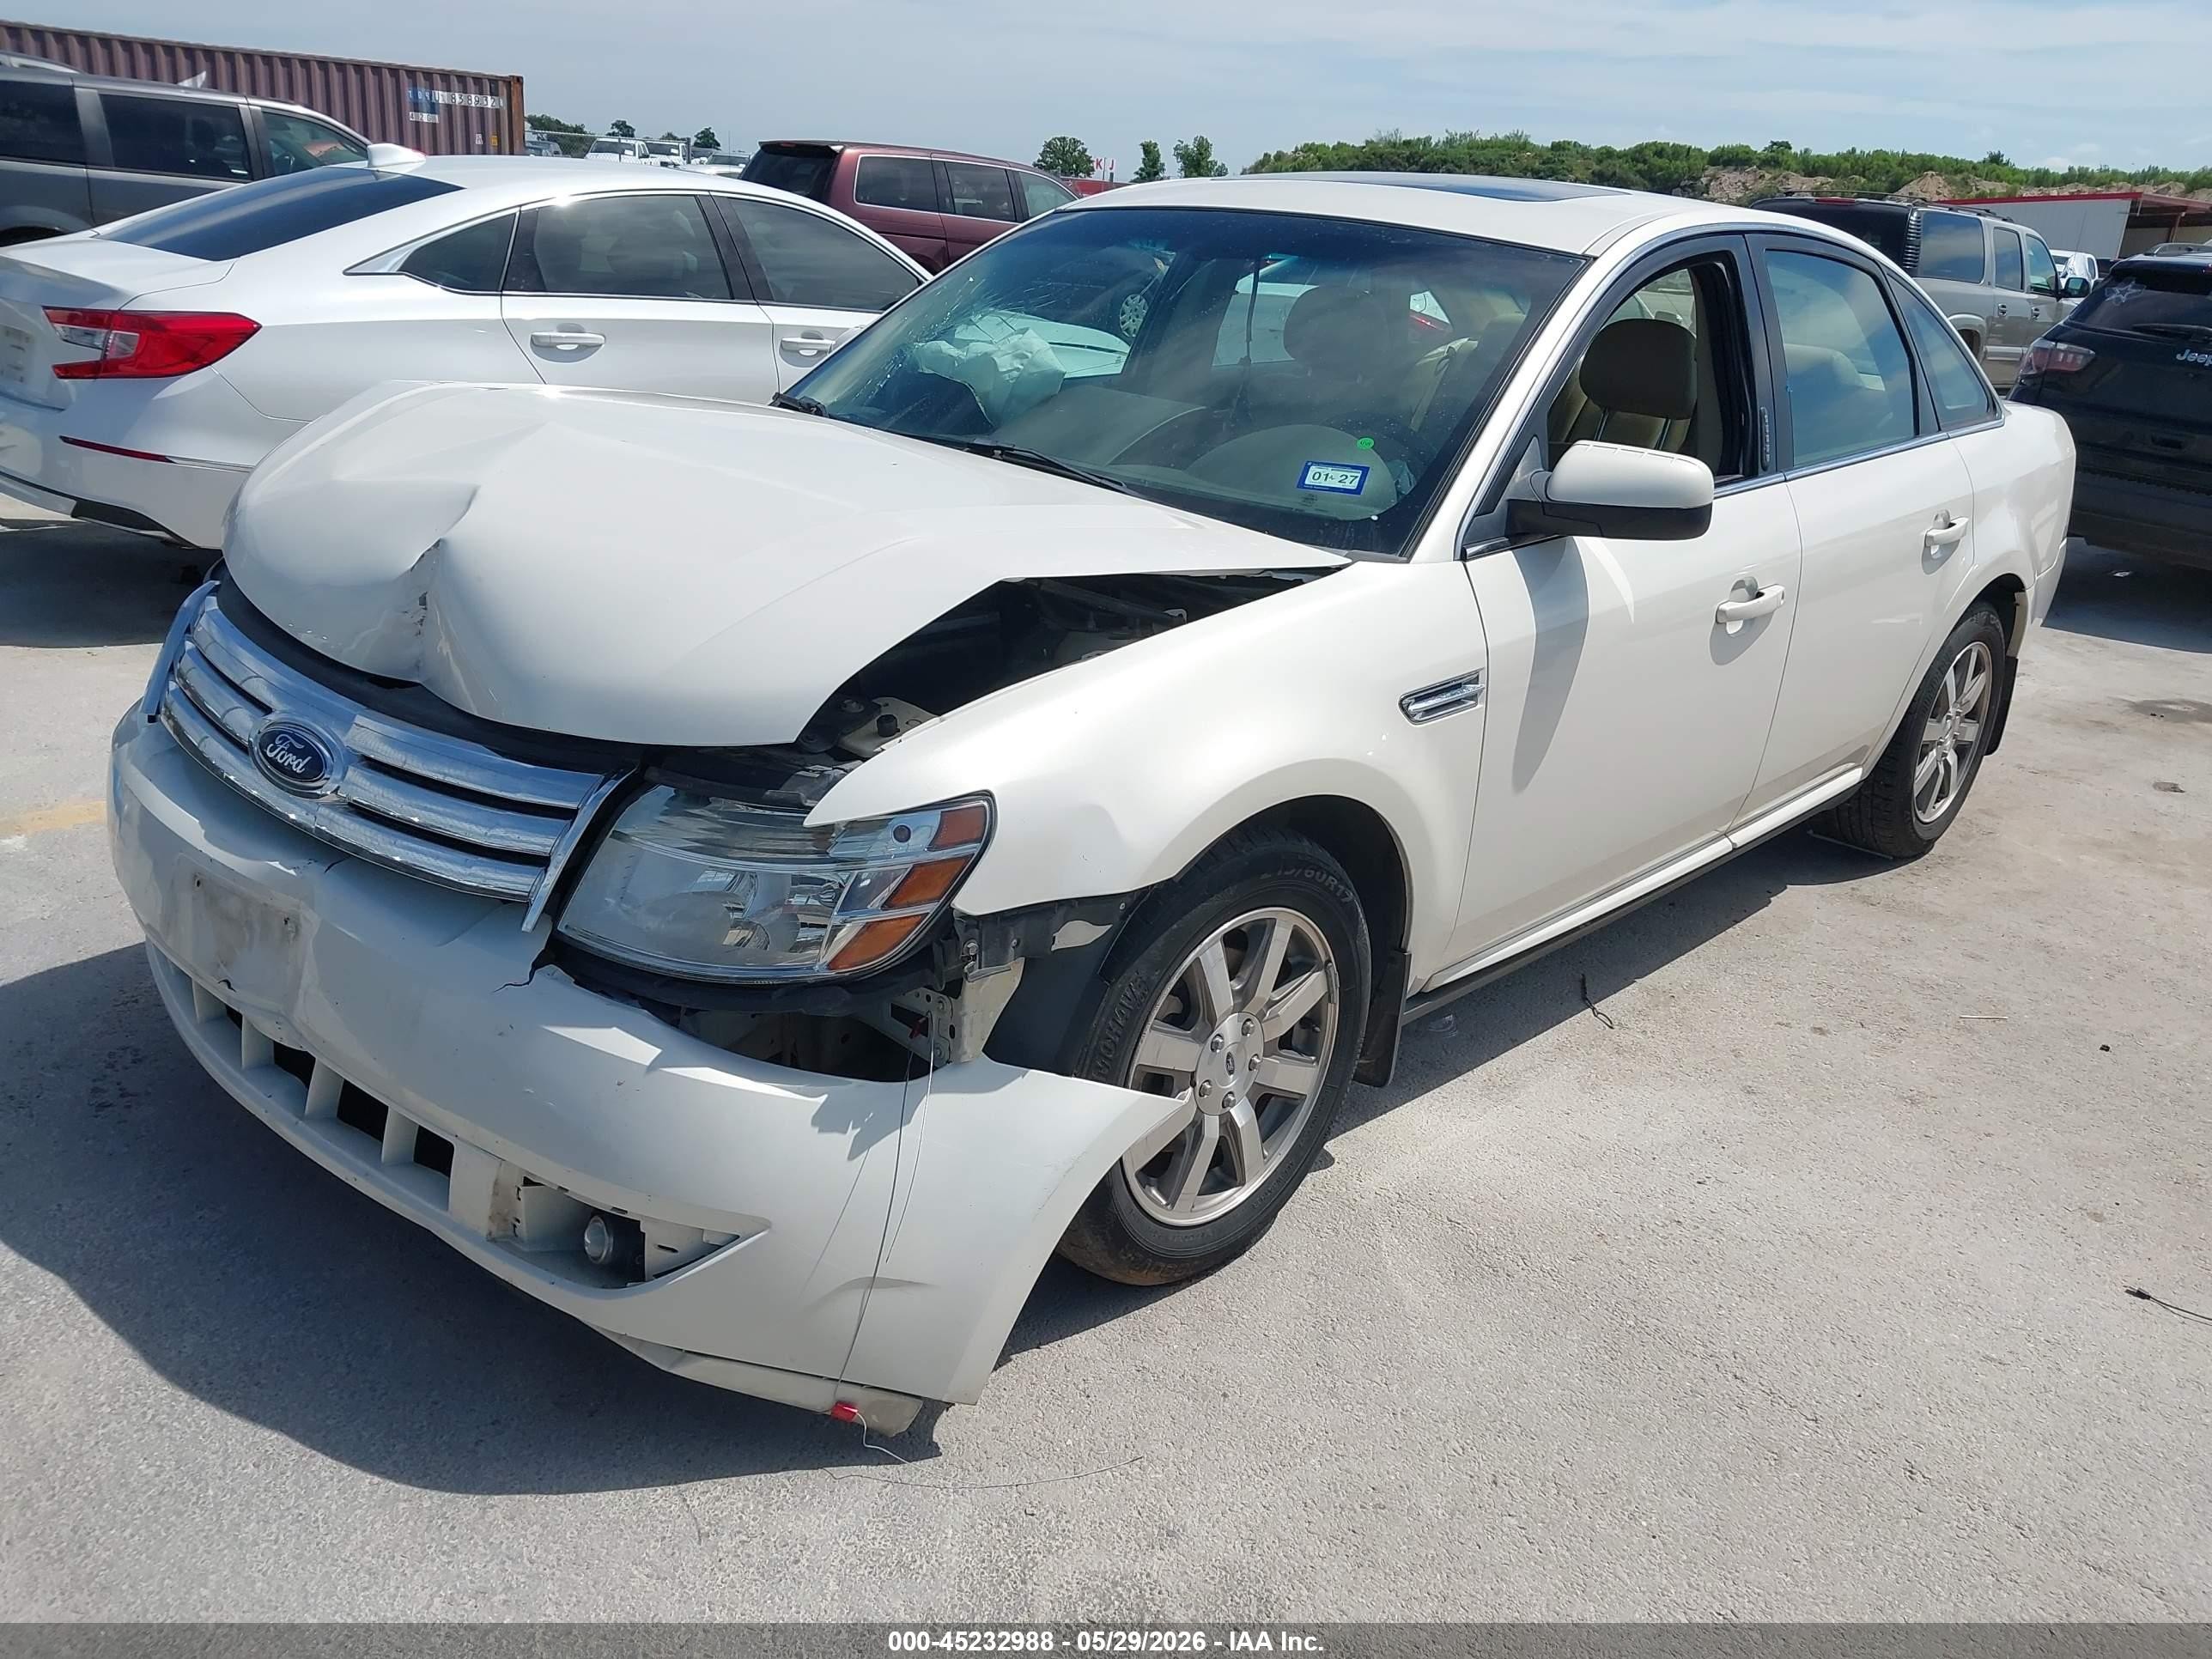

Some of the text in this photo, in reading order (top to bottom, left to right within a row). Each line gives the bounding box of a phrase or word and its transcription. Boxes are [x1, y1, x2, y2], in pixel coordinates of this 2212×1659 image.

[1095, 157, 1103, 170] K
[1311, 471, 1359, 484] 01 27
[266, 733, 313, 774] Ford
